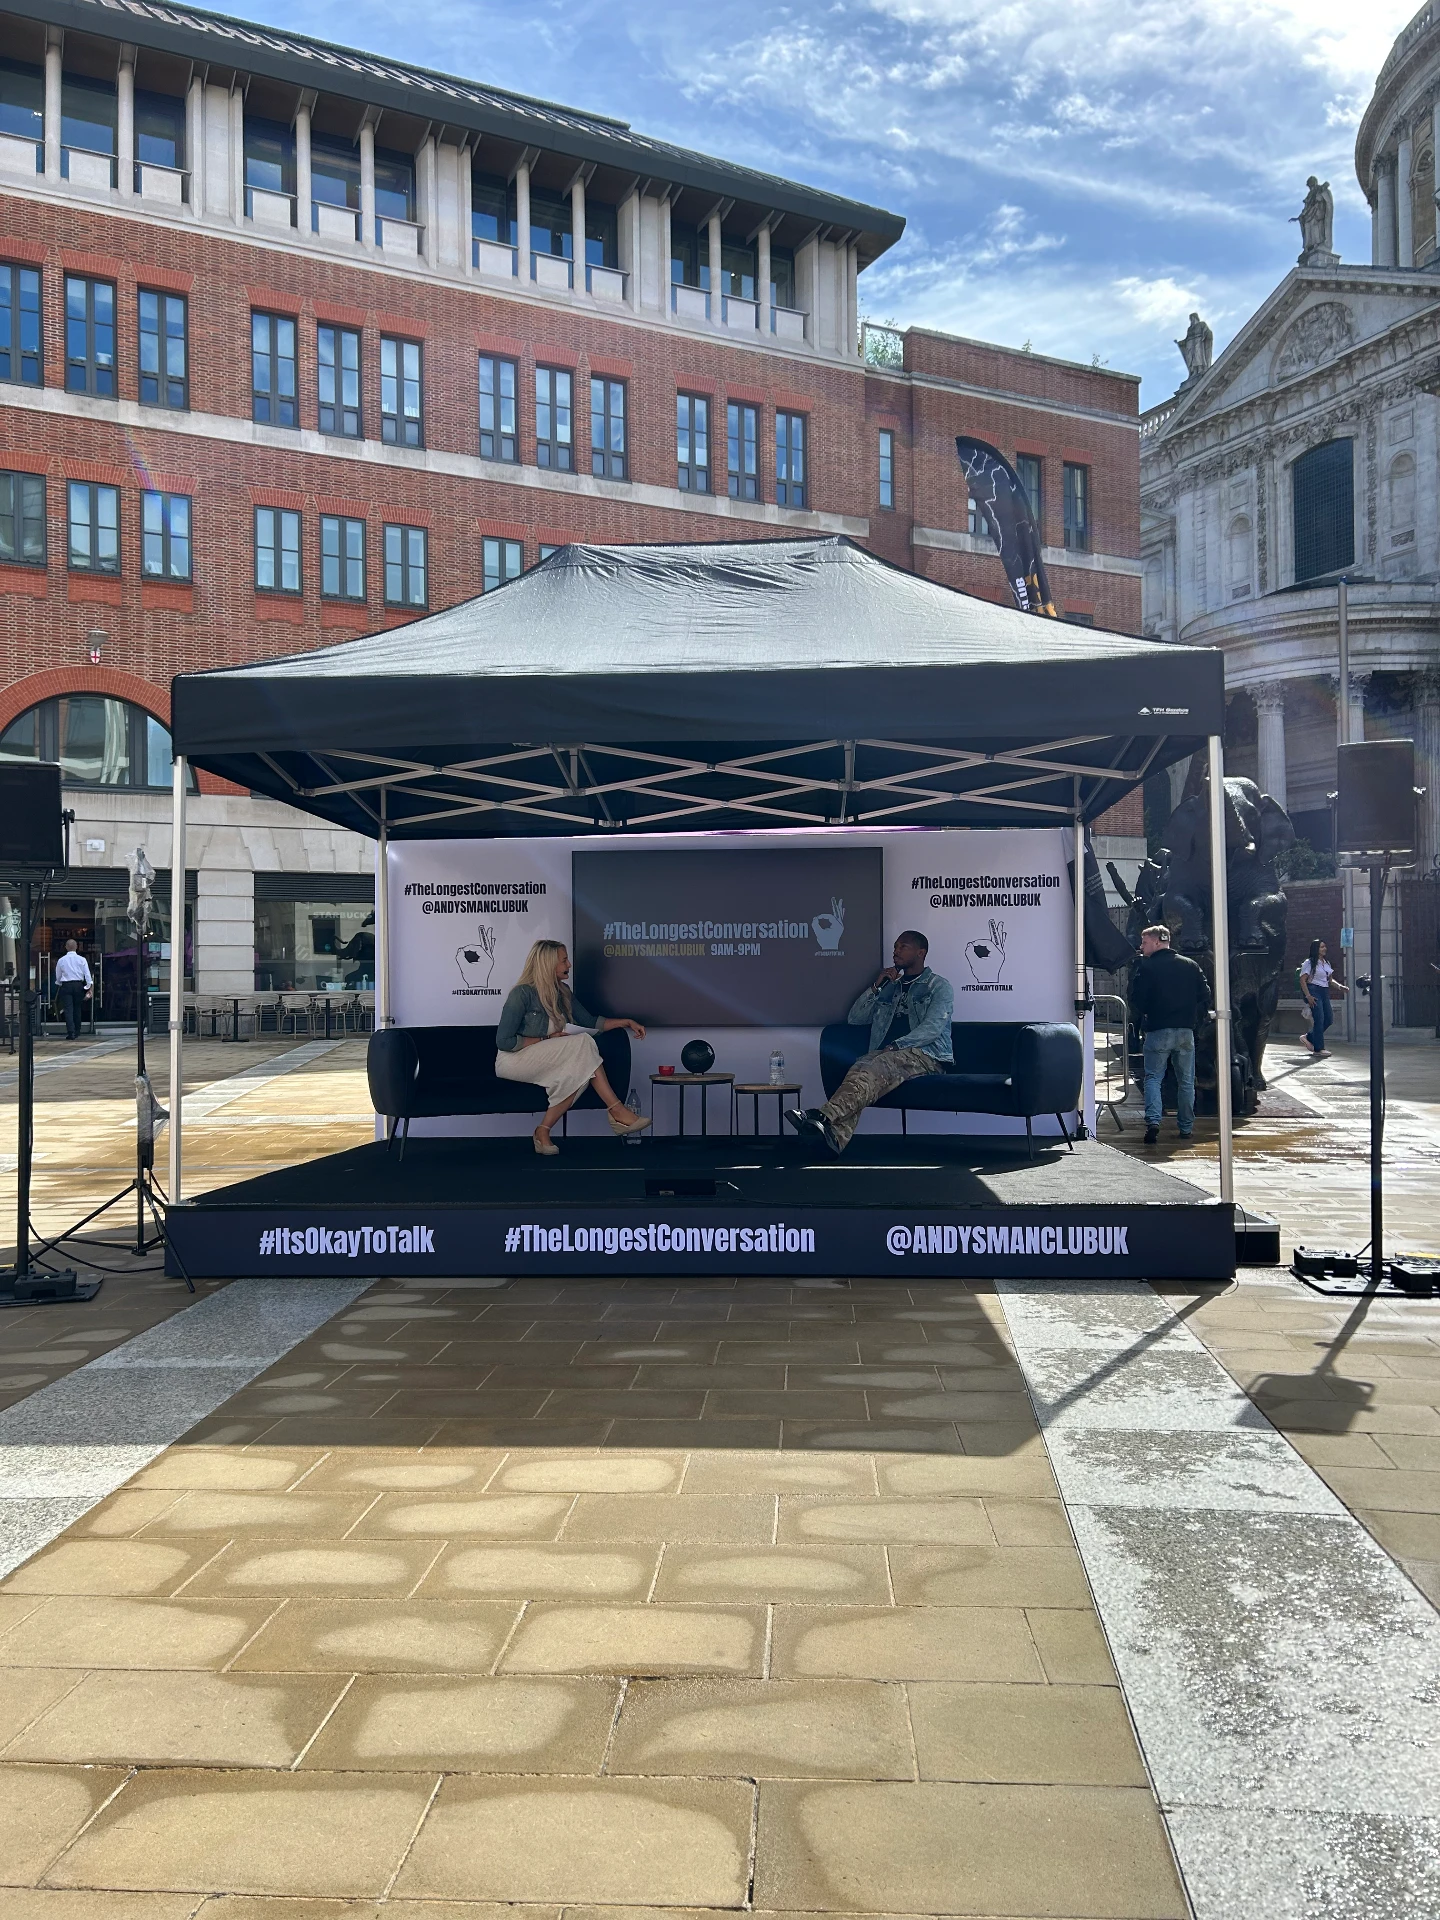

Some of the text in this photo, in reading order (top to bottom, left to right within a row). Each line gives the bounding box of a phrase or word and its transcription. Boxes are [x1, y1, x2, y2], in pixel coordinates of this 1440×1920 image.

[404, 881, 547, 897] #TheLongestConversation
[911, 873, 1060, 891] #TheLongestConversation
[422, 899, 529, 915] @ANDYSMANCLUBUK
[929, 893, 1041, 909] @ANDYSMANCLUBUK
[313, 911, 373, 919] STARBUCKS
[603, 920, 809, 942] #TheLongestConversation
[603, 943, 761, 957] @ANDYSMANCLUBUK 9AM-9PM
[452, 988, 502, 996] #ITSOKAYTOTALK
[961, 984, 1013, 992] #ITSOKAYTOTALK
[259, 1225, 435, 1258] #ItsOkayToTalk
[504, 1222, 816, 1256] #TheLongestConversation
[886, 1225, 1130, 1256] @ANDYSMANCLUBUK
